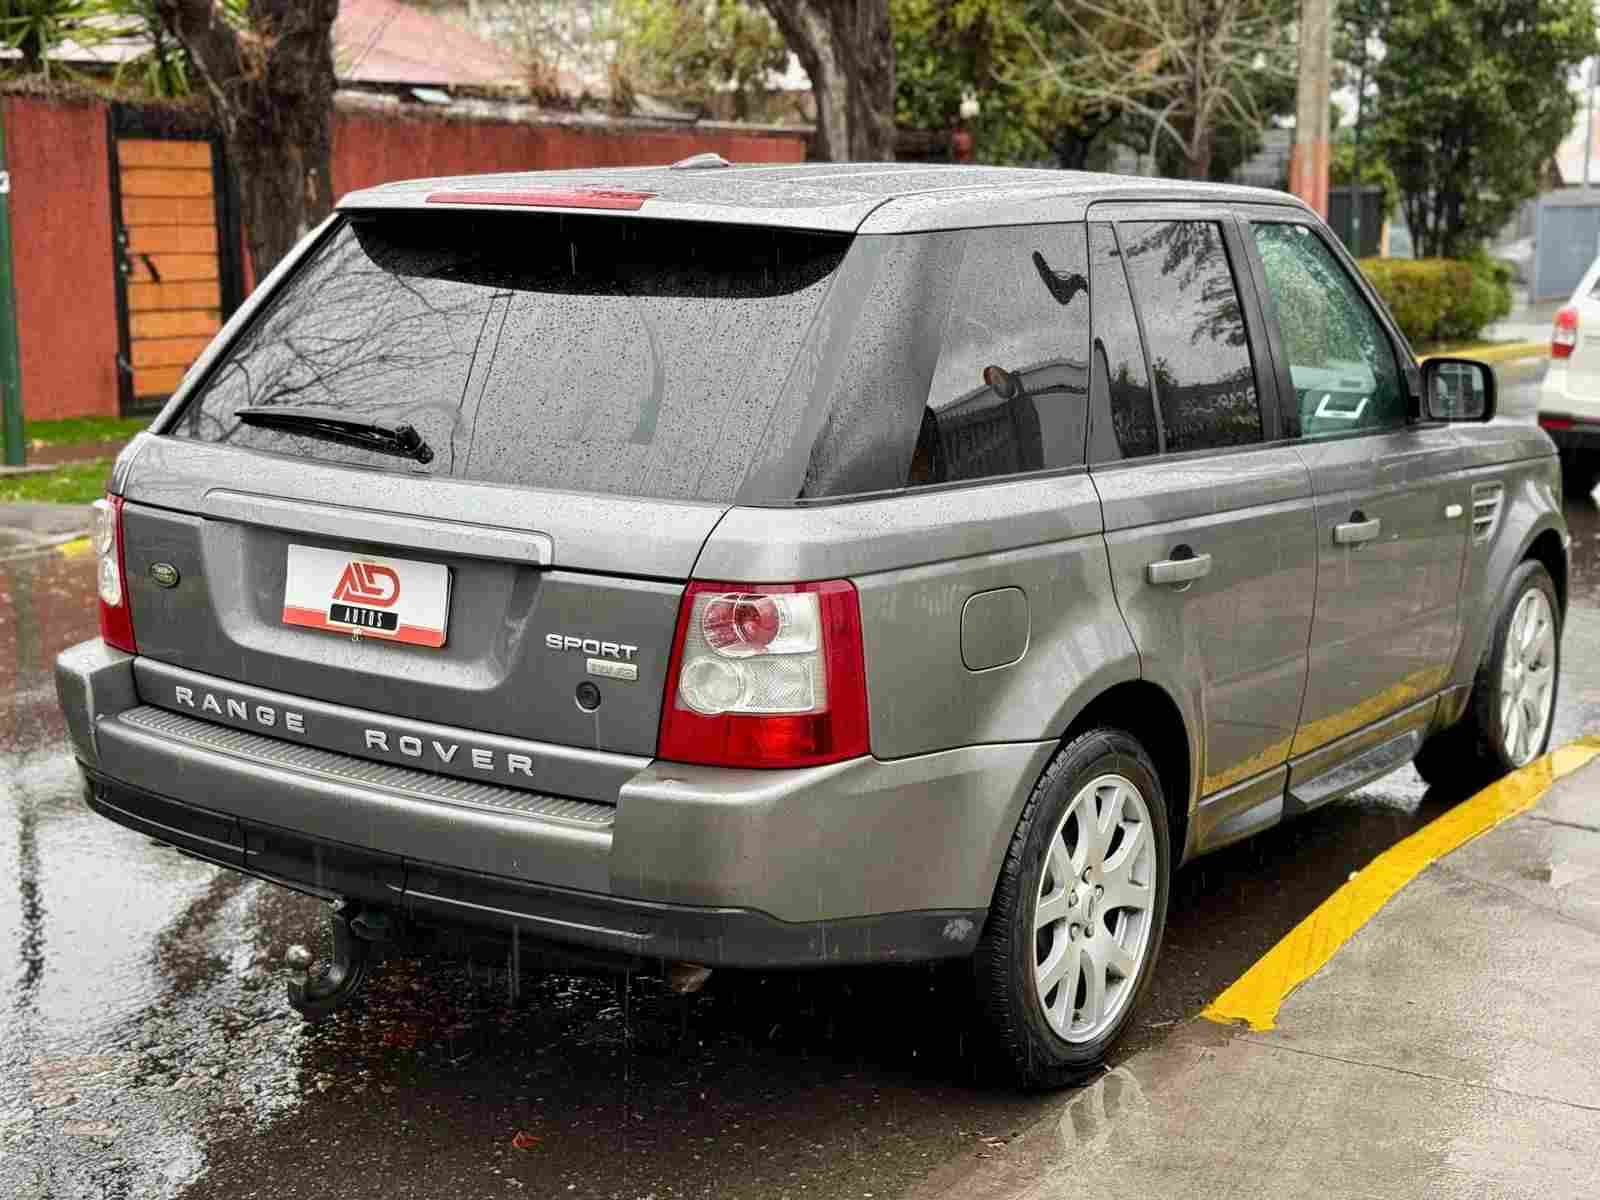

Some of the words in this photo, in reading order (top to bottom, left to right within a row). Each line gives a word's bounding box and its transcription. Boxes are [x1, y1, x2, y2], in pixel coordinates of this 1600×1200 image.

[344, 607, 384, 628] AUTOS
[545, 633, 638, 660] SPORT
[175, 686, 305, 733] RANGE
[365, 729, 534, 776] ROVER
